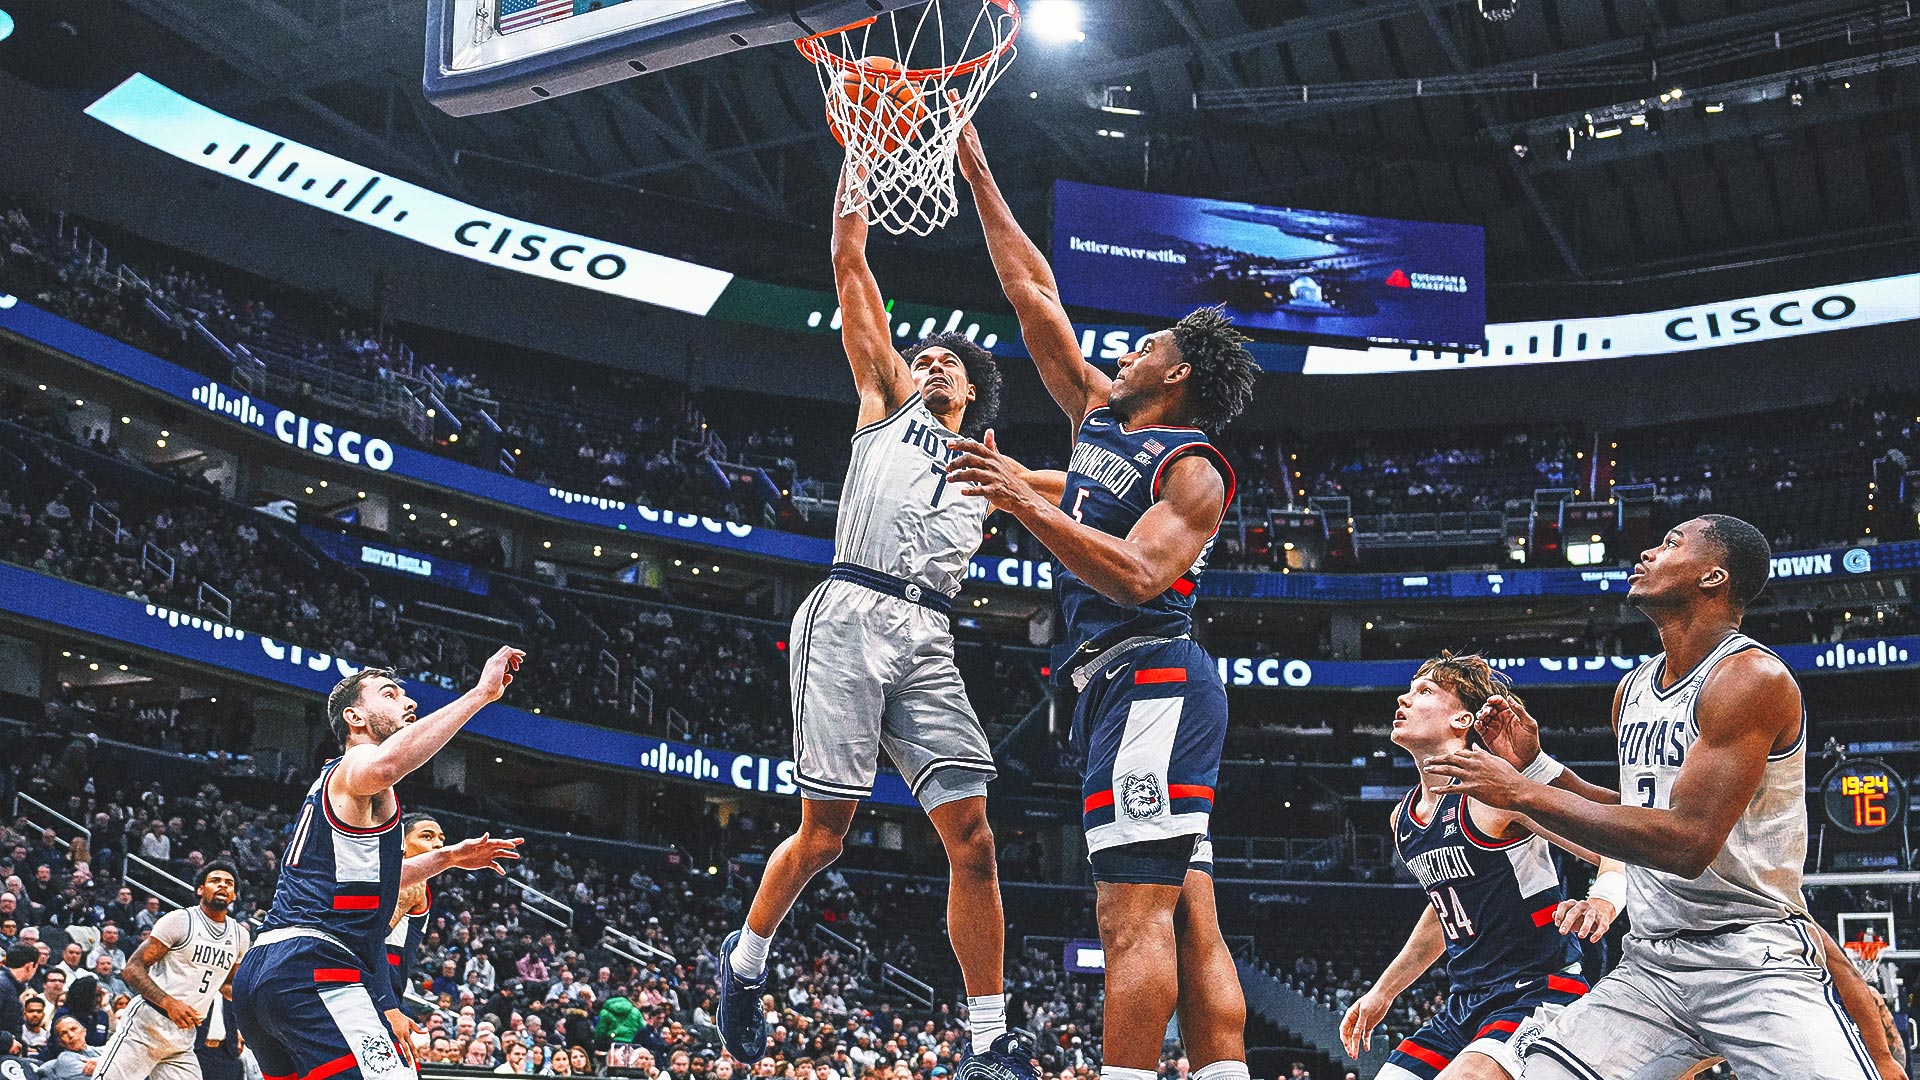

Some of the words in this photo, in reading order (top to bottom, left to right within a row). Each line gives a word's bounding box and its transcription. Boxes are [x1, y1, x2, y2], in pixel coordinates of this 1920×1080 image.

[454, 220, 627, 280] CISCO
[1070, 236, 1109, 254] Better
[1110, 245, 1145, 259] never
[1146, 249, 1187, 264] settles
[1665, 295, 1856, 342] CISCO
[274, 409, 394, 472] CISCO
[901, 418, 964, 465] HOY
[930, 462, 949, 508] 7
[1072, 487, 1090, 524] 5
[997, 557, 1053, 590] CIS
[1217, 657, 1312, 687] ISCO
[1620, 720, 1685, 767] HOYAS
[731, 754, 798, 795] CIS
[1842, 775, 1888, 795] 19:24
[1854, 793, 1887, 827] 16
[1430, 886, 1475, 940] 24
[191, 944, 234, 970] HOYAS
[199, 970, 213, 994] 5
